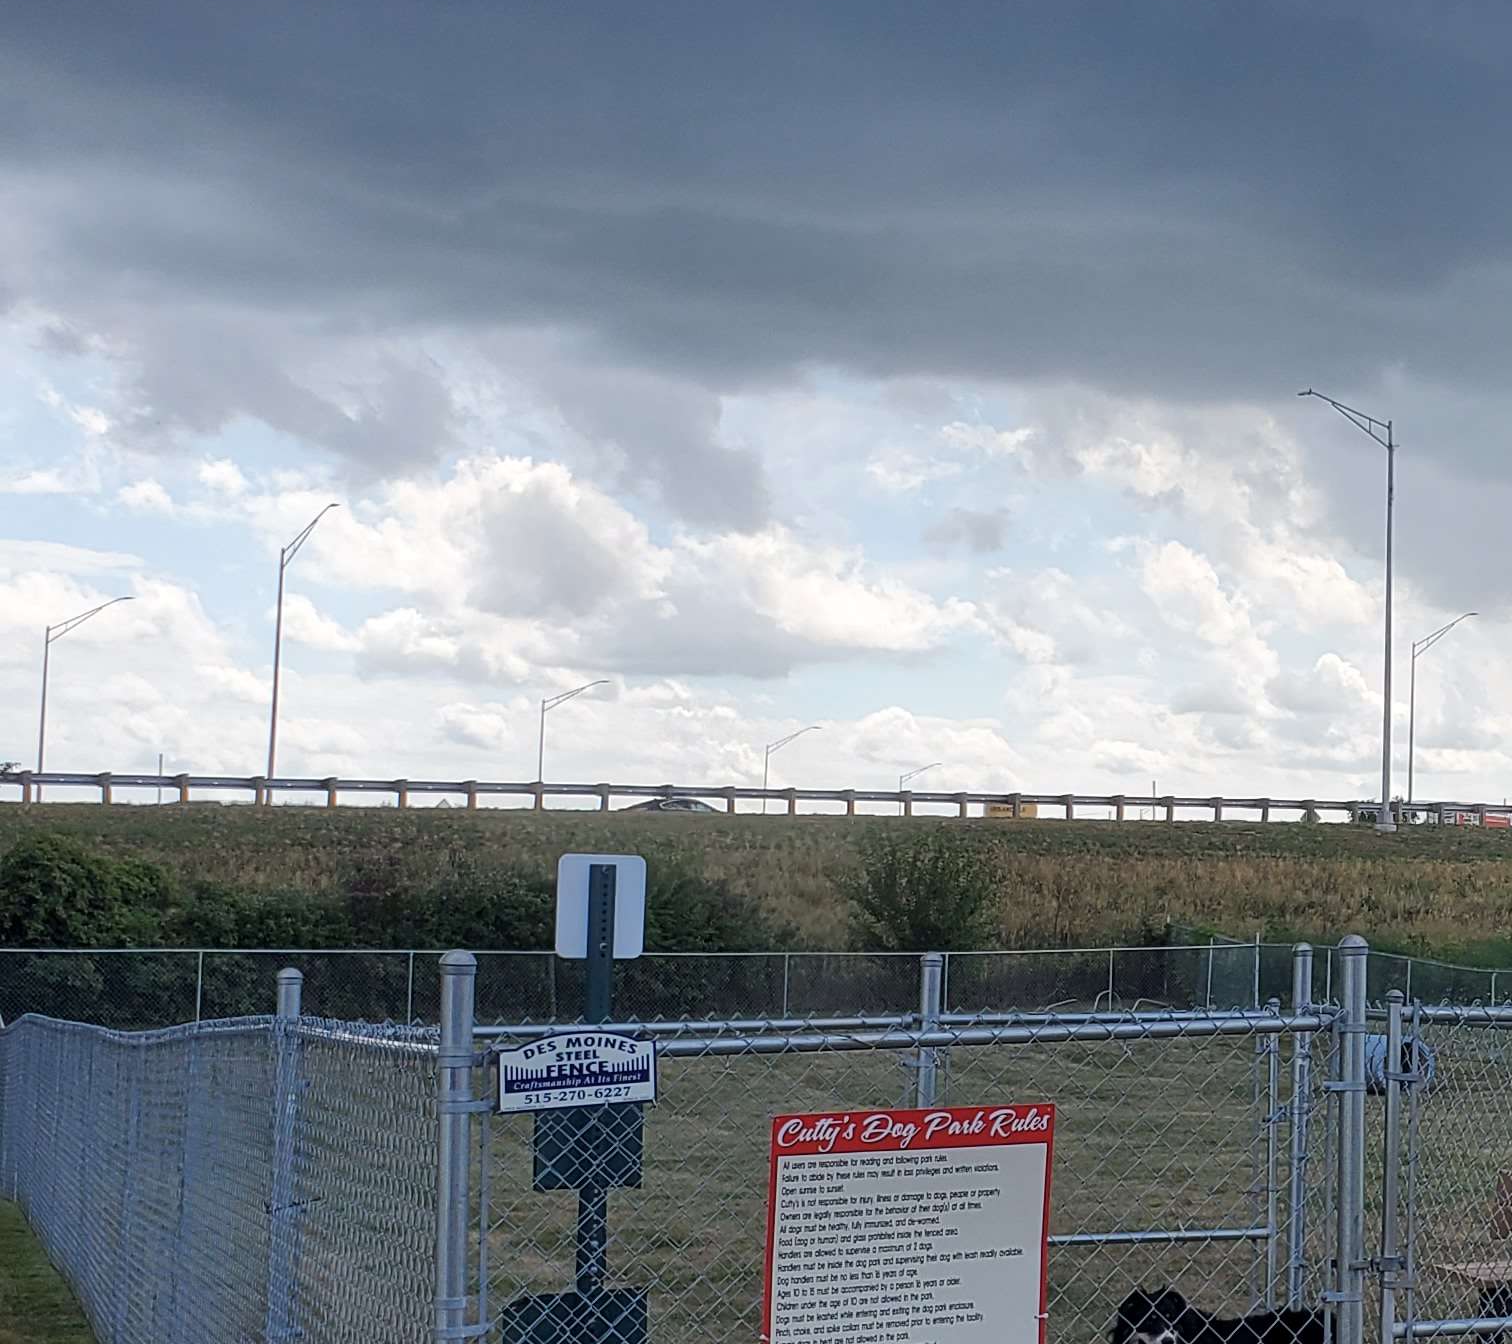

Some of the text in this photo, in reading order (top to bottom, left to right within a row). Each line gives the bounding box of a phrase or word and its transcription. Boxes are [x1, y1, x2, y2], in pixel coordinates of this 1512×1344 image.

[523, 1036, 638, 1060] DES MOINES
[555, 1049, 600, 1062] STEEL
[546, 1061, 609, 1077] FENCE
[513, 1073, 642, 1091] Craftsmanship At Its Finest
[524, 1086, 632, 1104] 515-270-6227
[777, 1108, 1051, 1153] Cutty's Dog Park Rules
